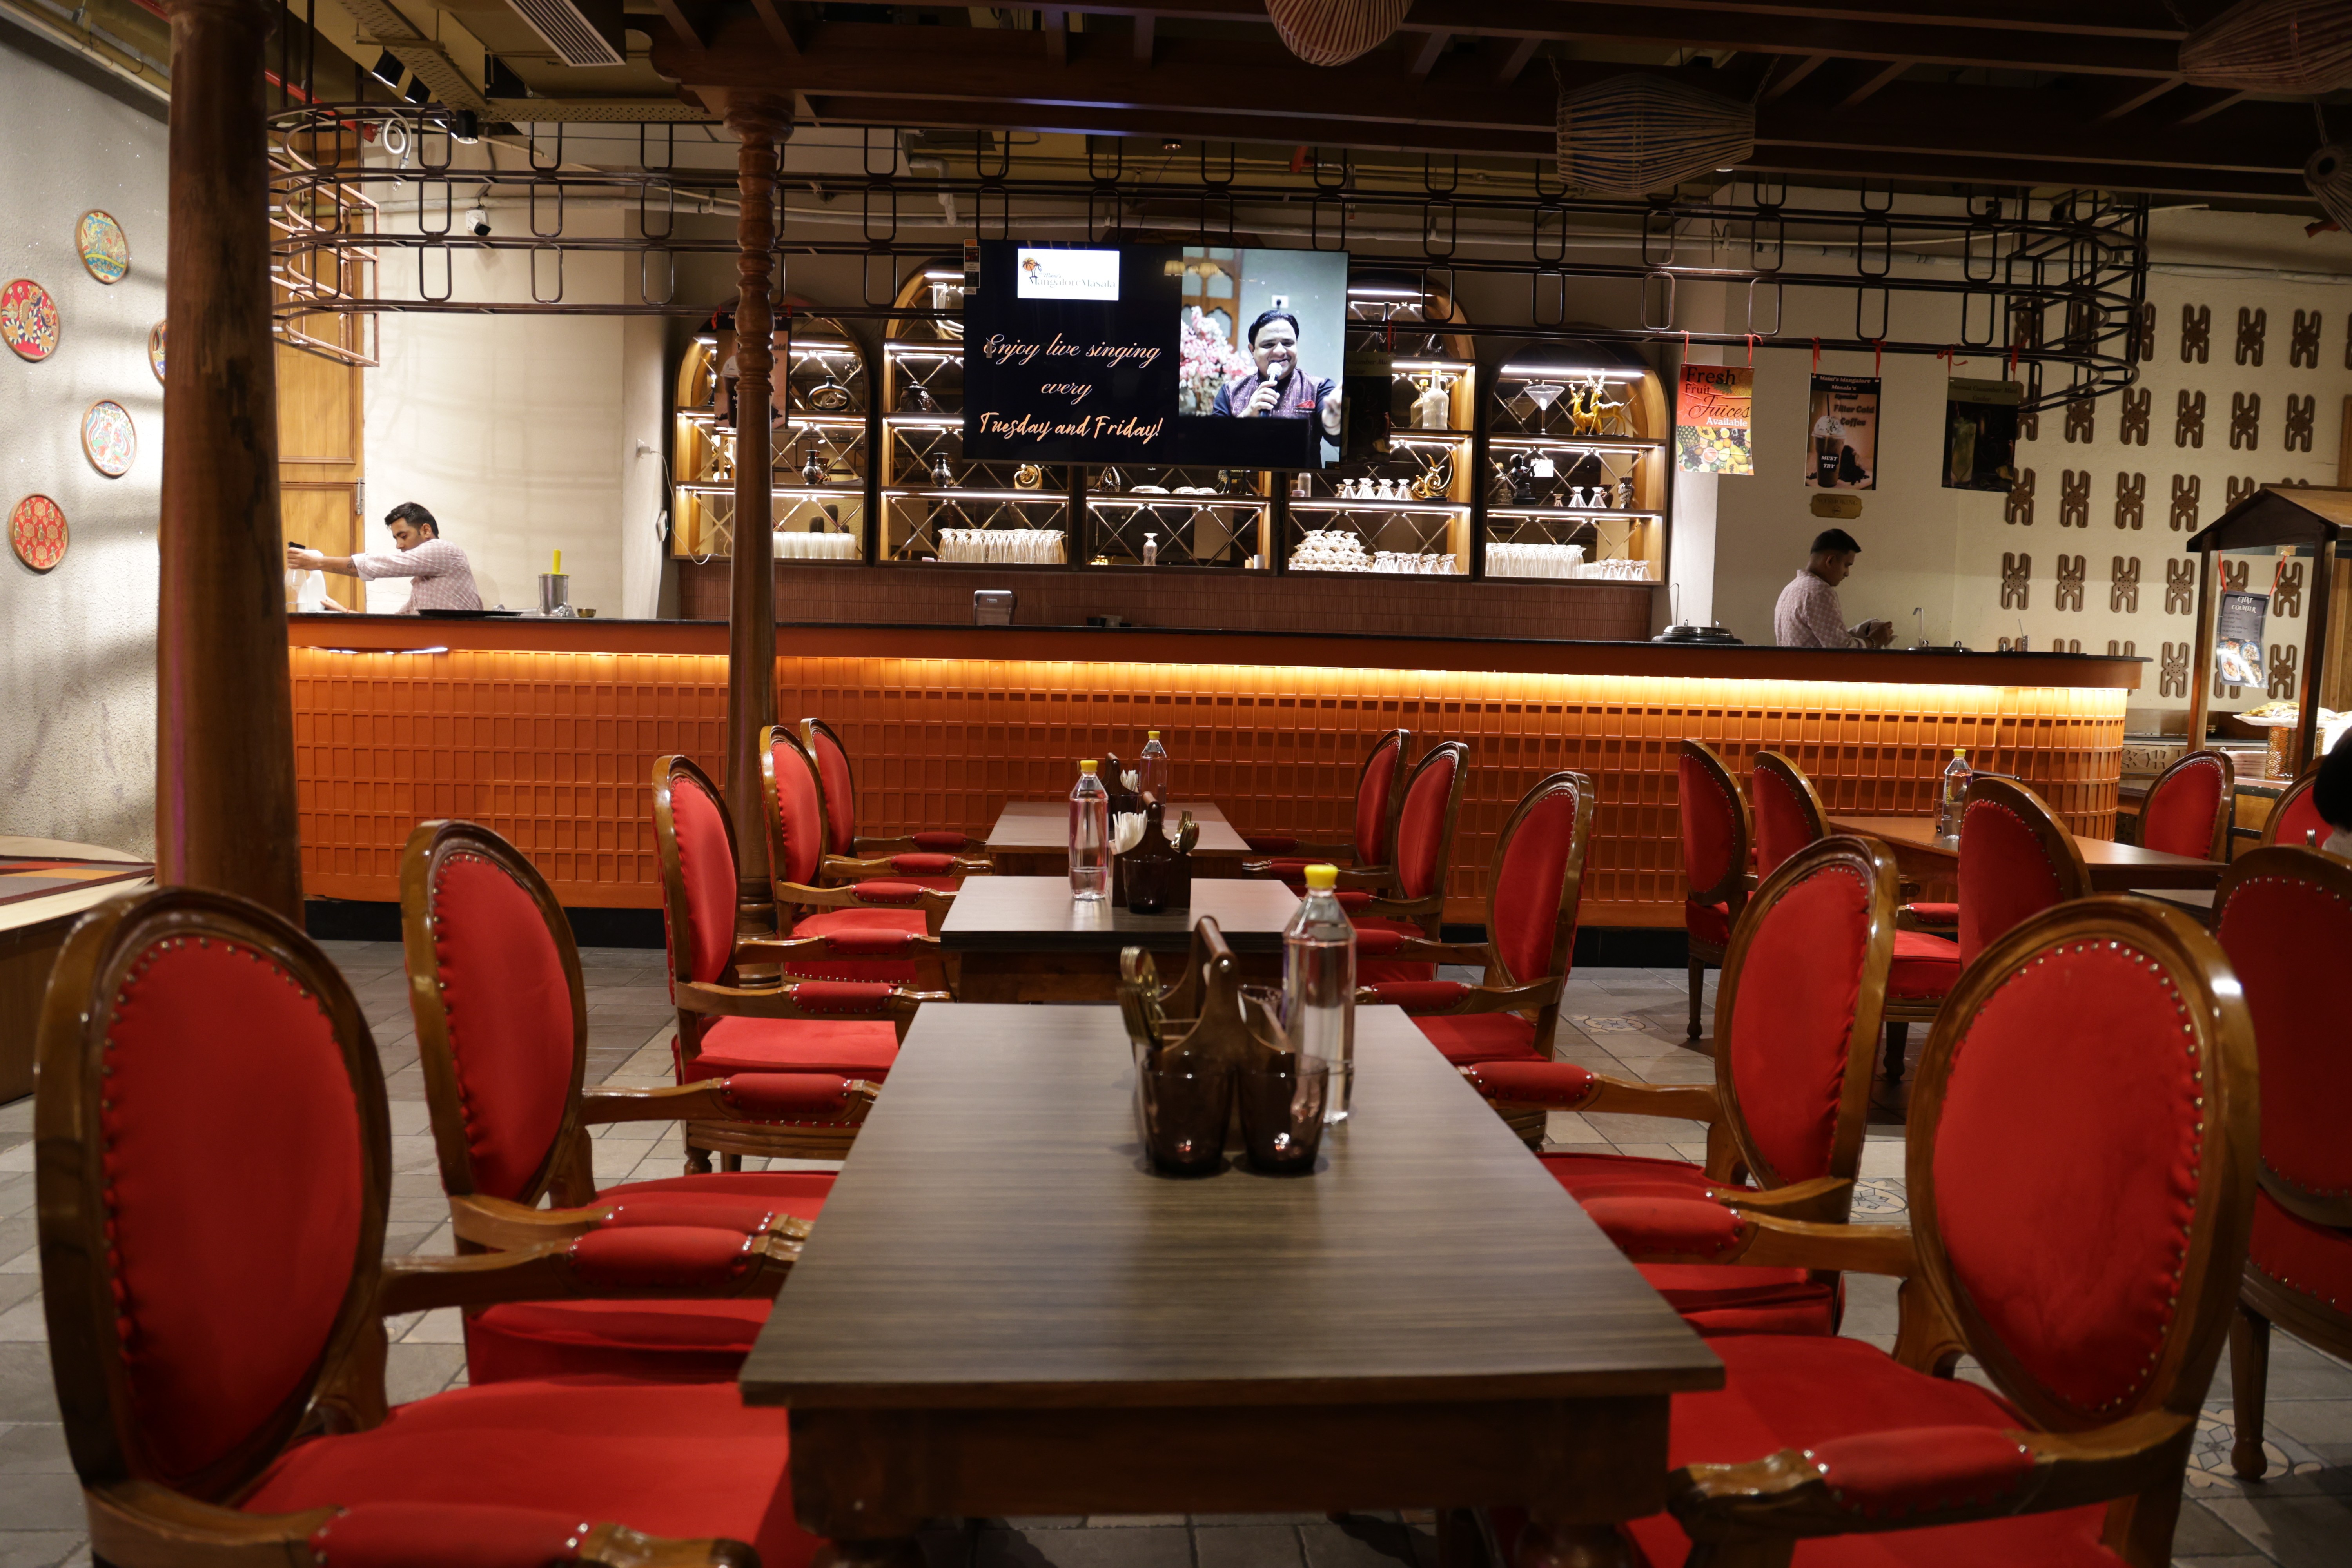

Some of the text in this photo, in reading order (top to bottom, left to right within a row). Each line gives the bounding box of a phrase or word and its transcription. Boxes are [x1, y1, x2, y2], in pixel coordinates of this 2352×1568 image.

[984, 333, 1161, 368] Enjoy live singing
[1686, 367, 1736, 385] Fresh
[1041, 382, 1093, 405] every
[1685, 384, 1711, 394] Fruit
[1688, 395, 1751, 419] Juices
[1833, 404, 1855, 412] Filter
[980, 412, 1163, 445] Tuesday and Friday!
[1706, 417, 1748, 427] Available
[1840, 418, 1866, 427] Coffee
[2232, 604, 2257, 613] COUNTER
